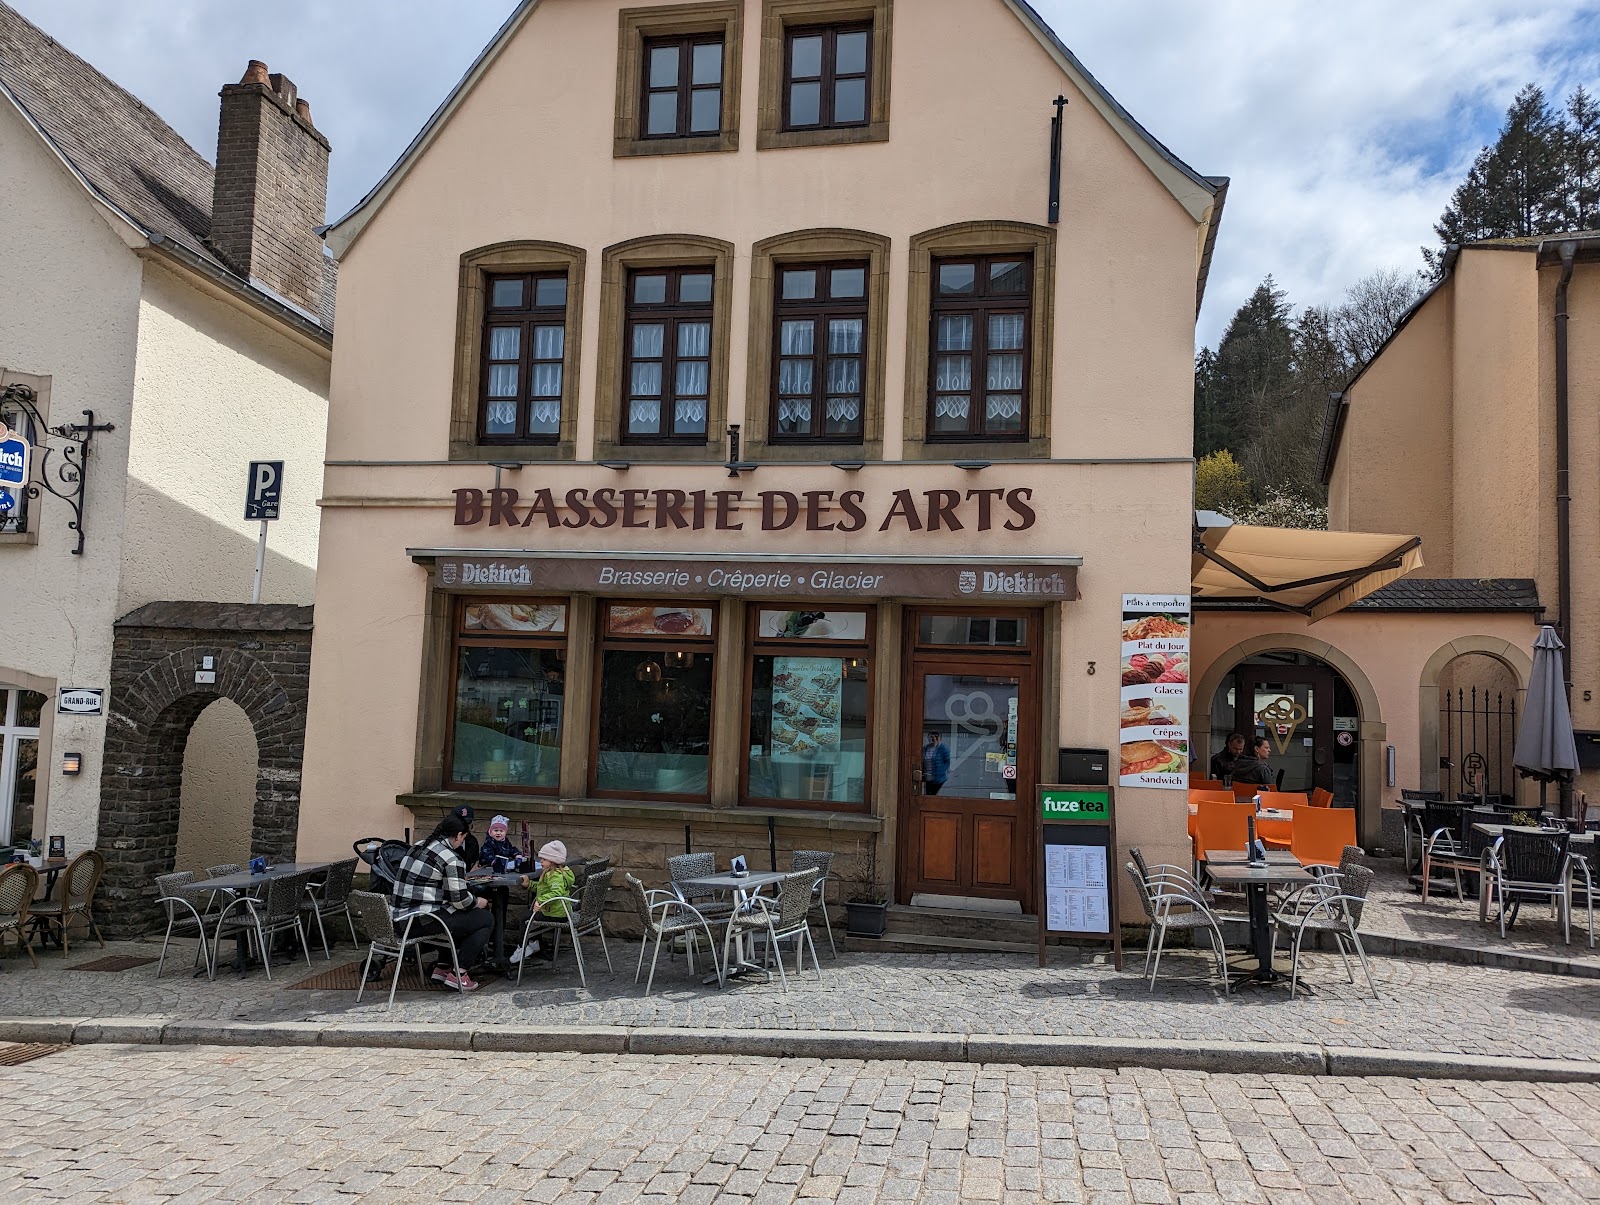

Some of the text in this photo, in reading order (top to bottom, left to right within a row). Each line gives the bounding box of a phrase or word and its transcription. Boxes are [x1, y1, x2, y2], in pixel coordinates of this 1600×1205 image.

[254, 463, 276, 500] P
[261, 499, 279, 508] Gare
[451, 487, 1036, 532] BRASSERIE DES ARTS
[461, 562, 532, 585] Diekirch
[598, 567, 884, 592] Brasserie Crêperie Glacier
[982, 570, 1066, 595] Diekirch
[1126, 599, 1144, 607] Plats
[1152, 600, 1186, 609] emporter
[1138, 641, 1185, 651] Plat du Jour
[1087, 661, 1096, 675] 3
[1154, 685, 1184, 695] Glaces
[1583, 690, 1592, 701] 5
[63, 696, 97, 706] GRAND-RUE
[1152, 727, 1183, 739] Crêpes
[1139, 774, 1183, 785] Sandwich
